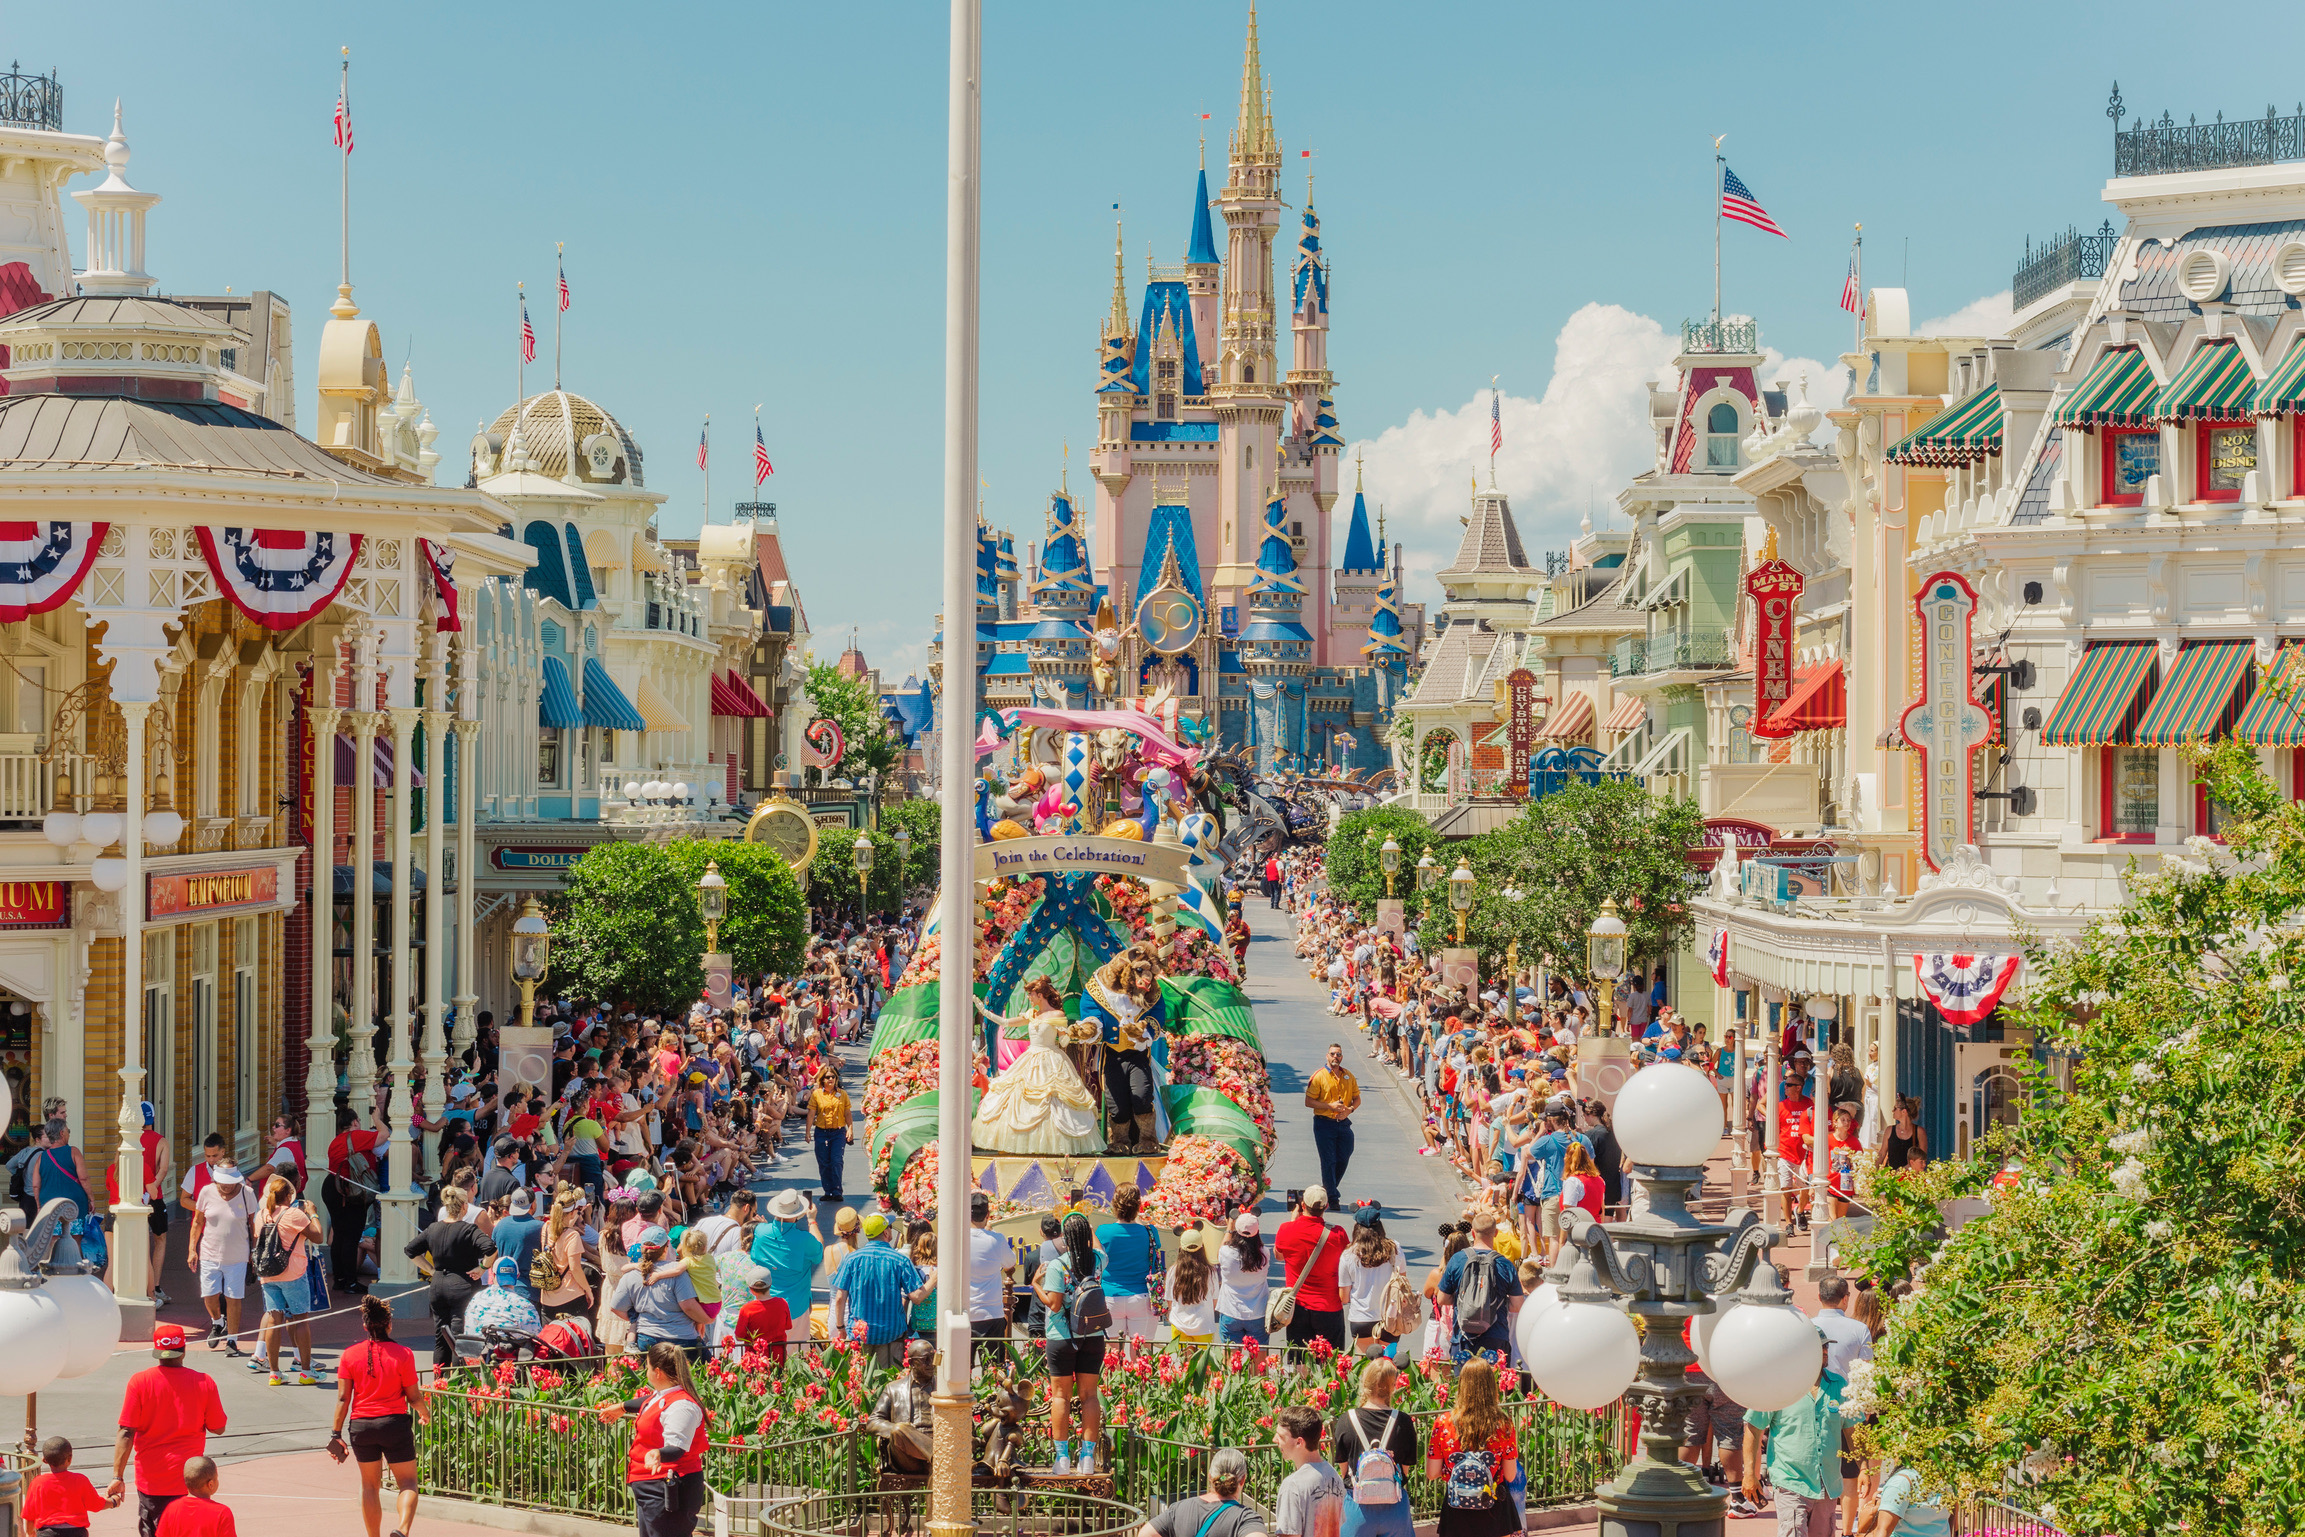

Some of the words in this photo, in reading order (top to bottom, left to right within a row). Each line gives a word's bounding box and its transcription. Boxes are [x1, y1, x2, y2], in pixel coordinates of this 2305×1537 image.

[2222, 435, 2252, 446] ROY
[2232, 446, 2243, 457] O
[1752, 573, 1797, 591] MAIN
[1779, 581, 1801, 592] ST.
[1152, 600, 1194, 645] 50
[1762, 598, 1788, 720] CINEMA
[1516, 686, 1527, 741] CRYSTAL
[1938, 605, 1956, 853] CONFECTIONERY
[1516, 749, 1527, 781] ARTS
[813, 815, 845, 829] SHION
[1706, 826, 1733, 835] MAIN
[992, 849, 1023, 869] Join
[1028, 849, 1048, 861] the
[1053, 846, 1147, 865] Celebration!
[187, 873, 253, 907] EMPORIUM
[503, 1050, 548, 1086] 50
